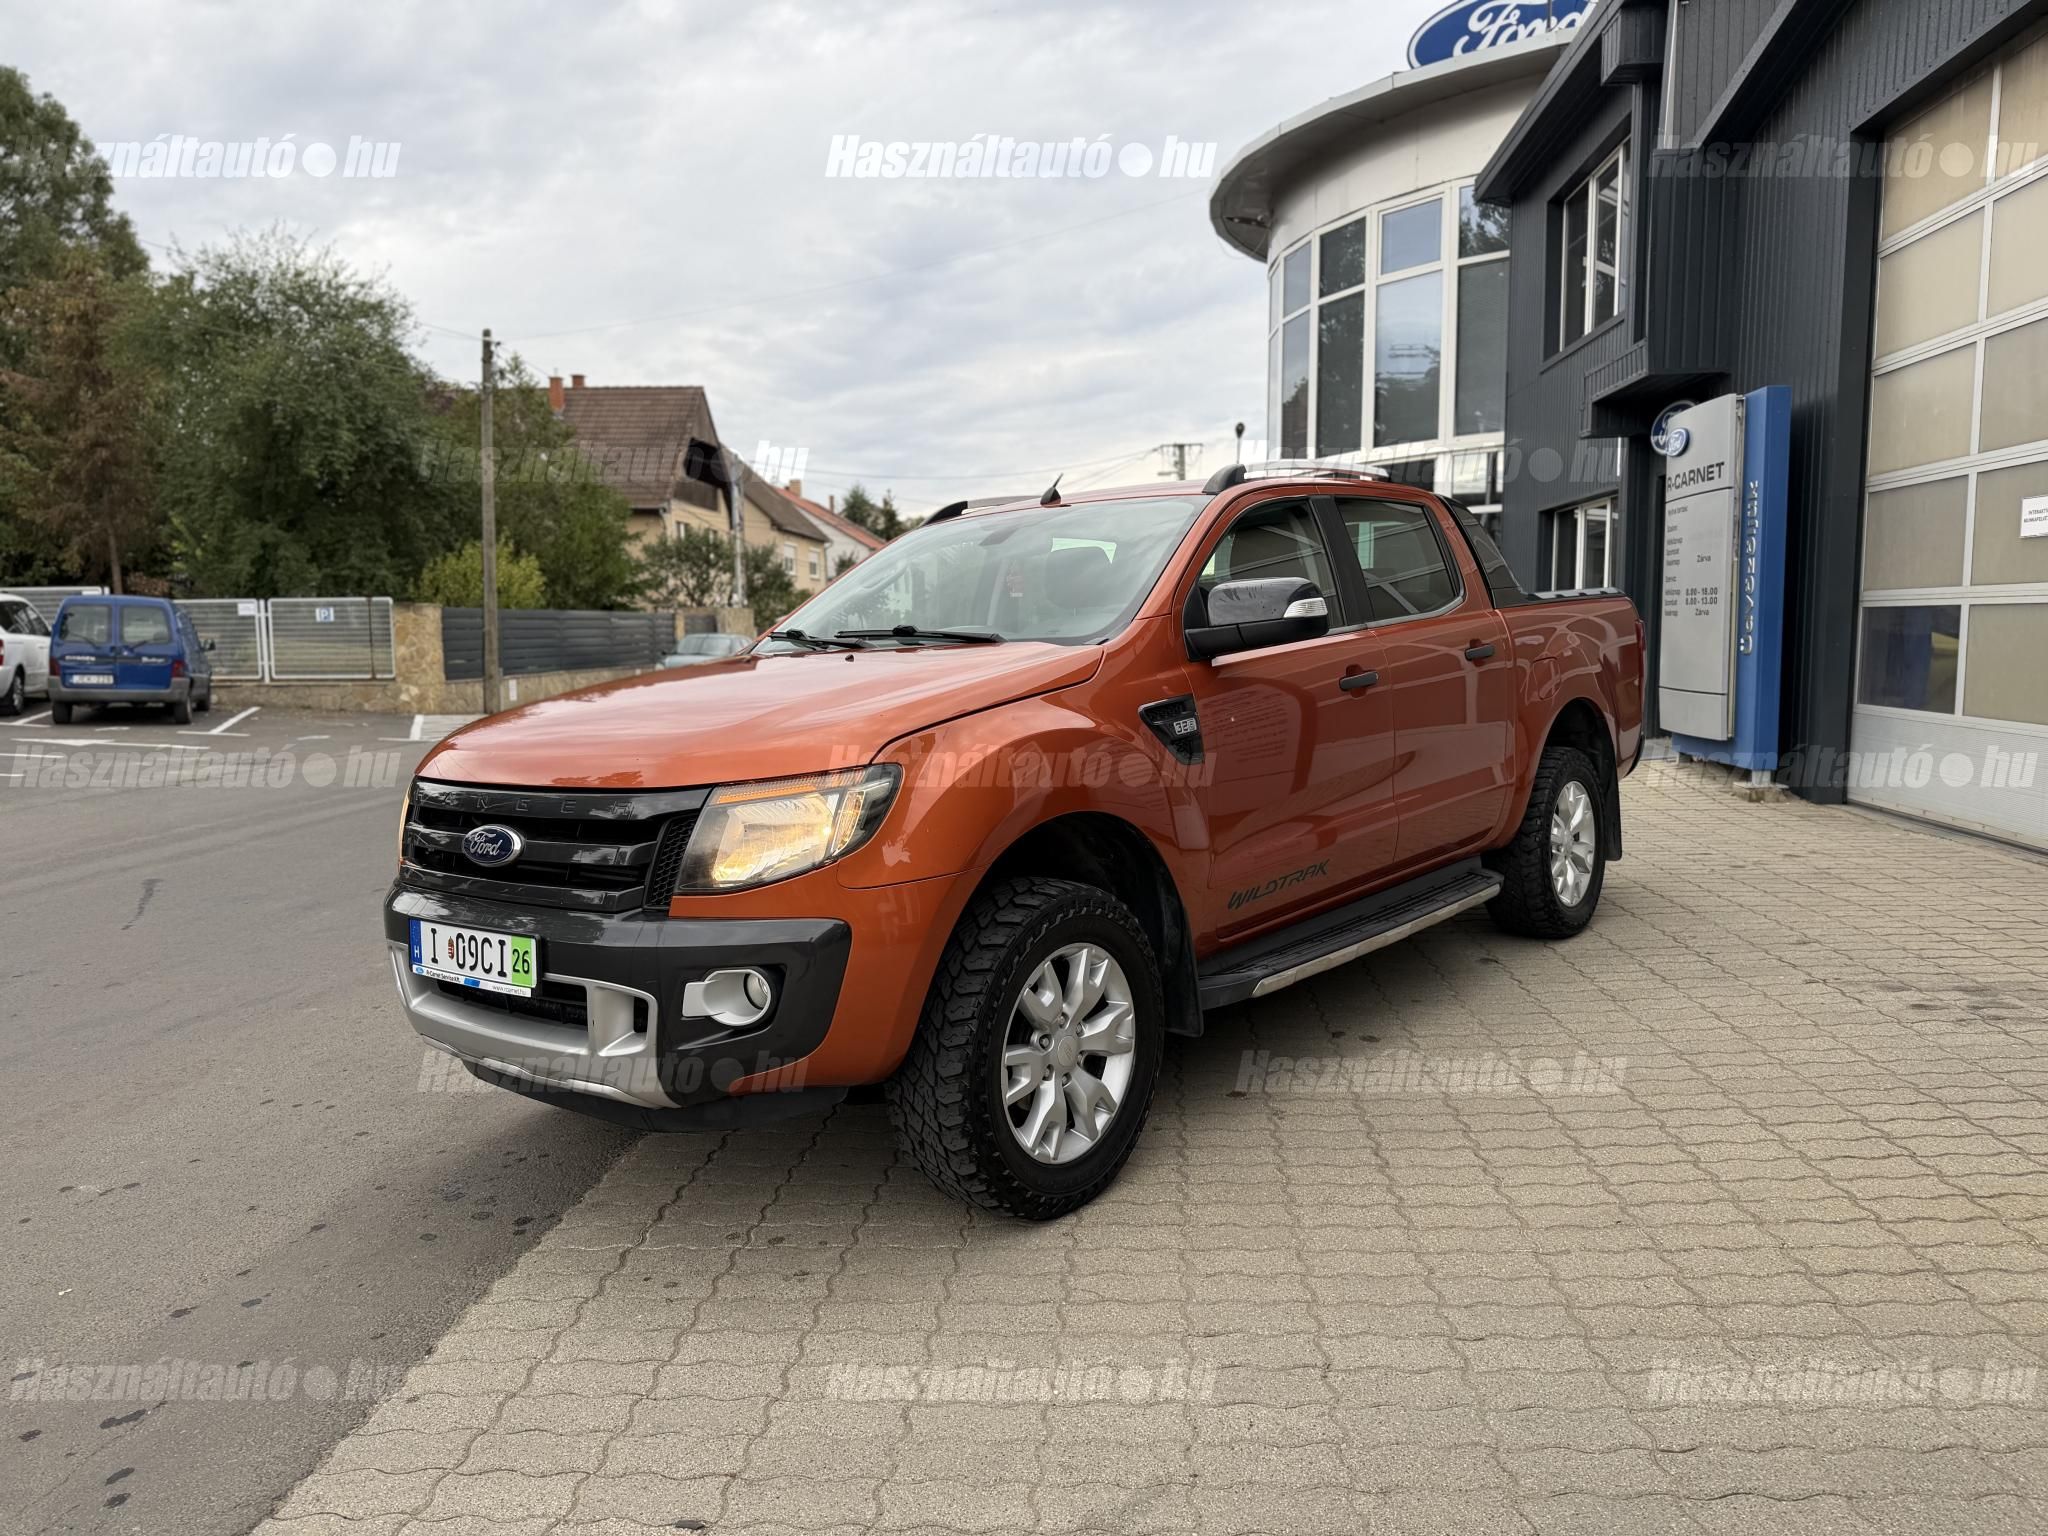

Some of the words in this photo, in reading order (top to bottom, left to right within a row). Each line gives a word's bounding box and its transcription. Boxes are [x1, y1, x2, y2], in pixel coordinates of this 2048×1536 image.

[1453, 0, 1598, 57] Ford
[1667, 461, 1725, 493] R-CARNET
[469, 831, 502, 856] Ford
[1228, 859, 1331, 910] WILDTRAK
[414, 945, 420, 958] H
[512, 948, 530, 975] 26
